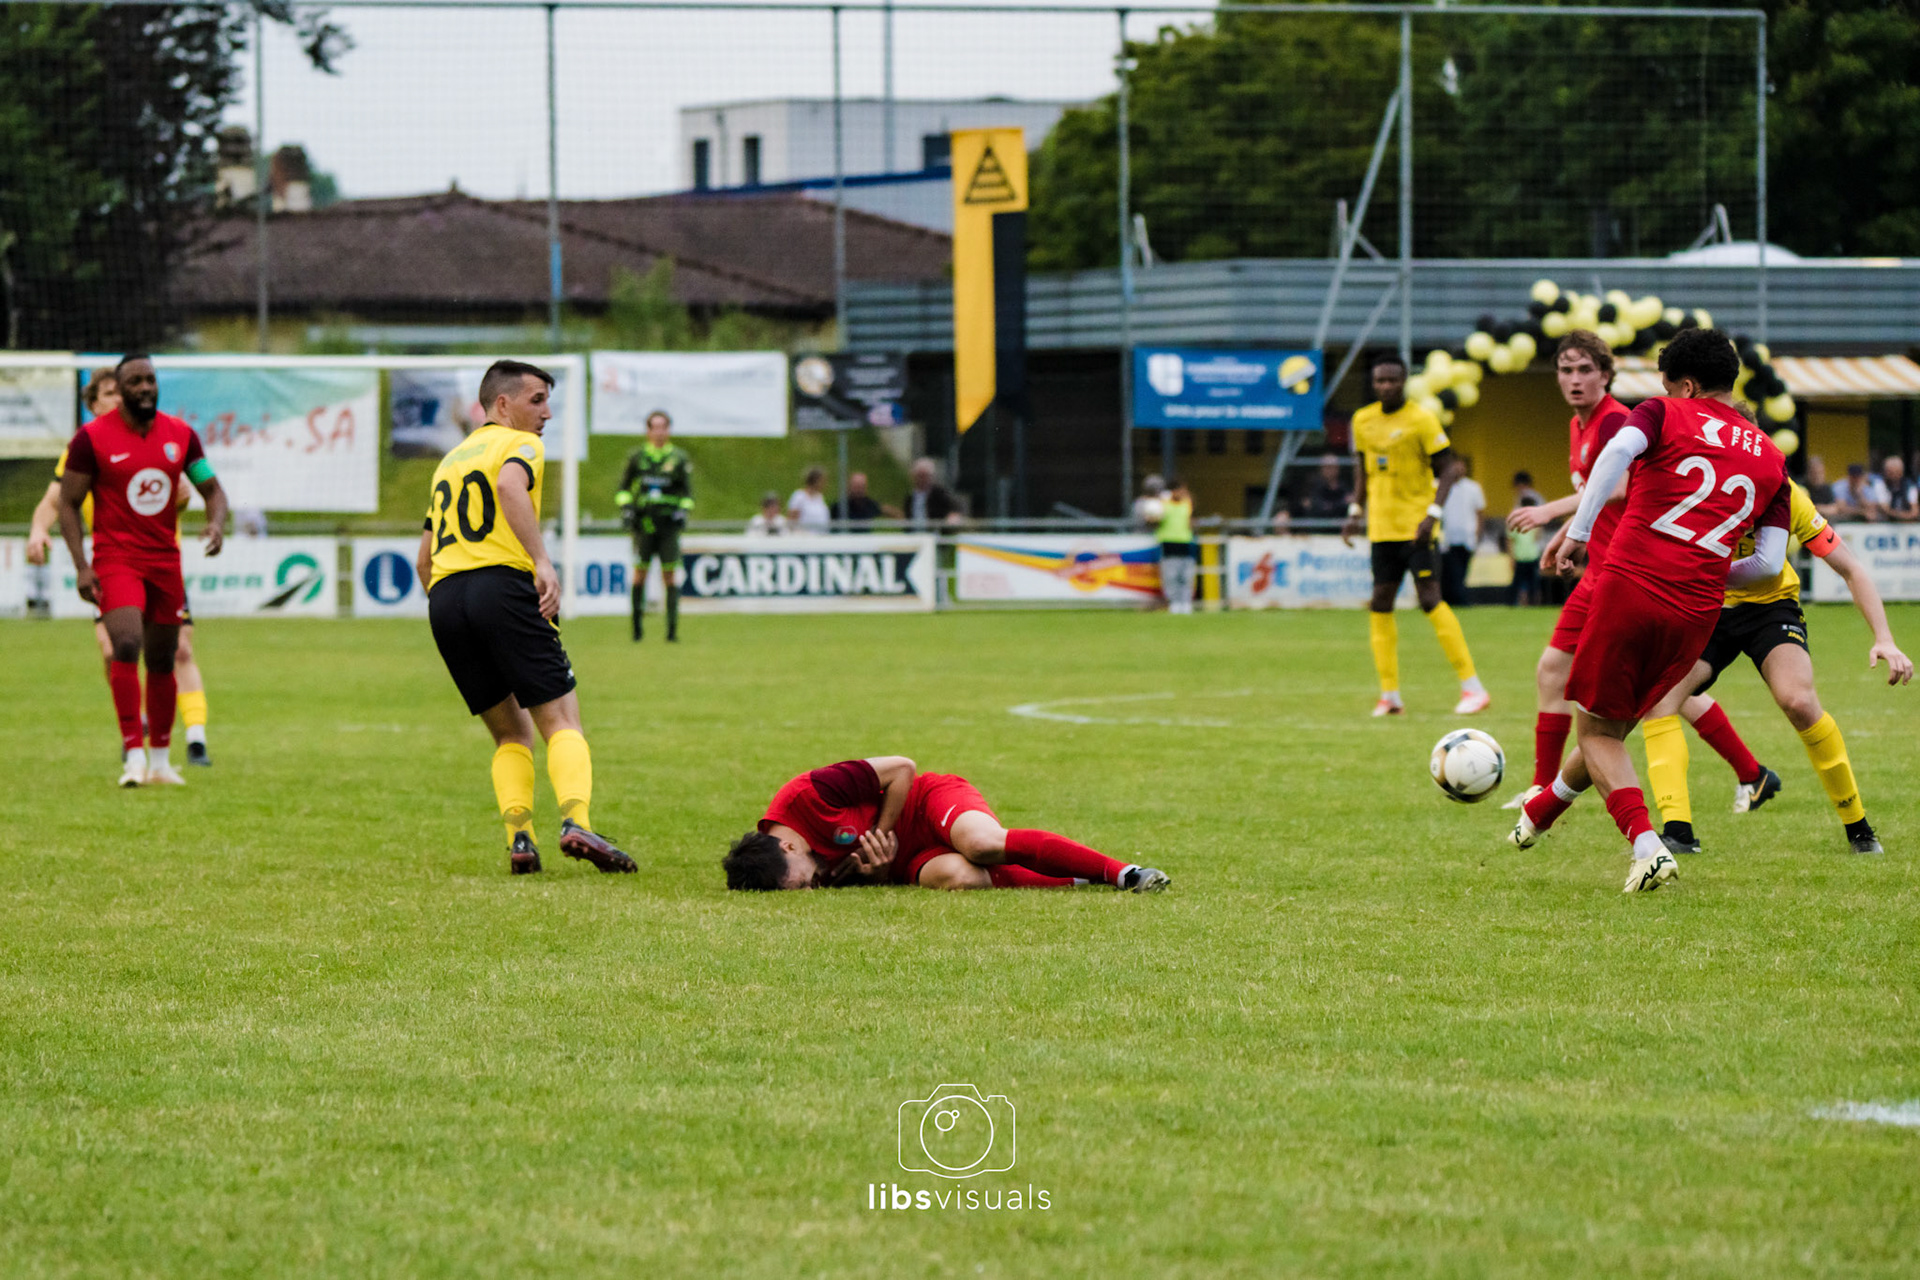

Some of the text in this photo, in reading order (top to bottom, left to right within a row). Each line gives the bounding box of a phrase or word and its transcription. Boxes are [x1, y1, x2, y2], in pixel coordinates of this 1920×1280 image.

[431, 469, 496, 557] 20
[1650, 455, 1756, 558] 22
[690, 553, 907, 598] CARDINAL
